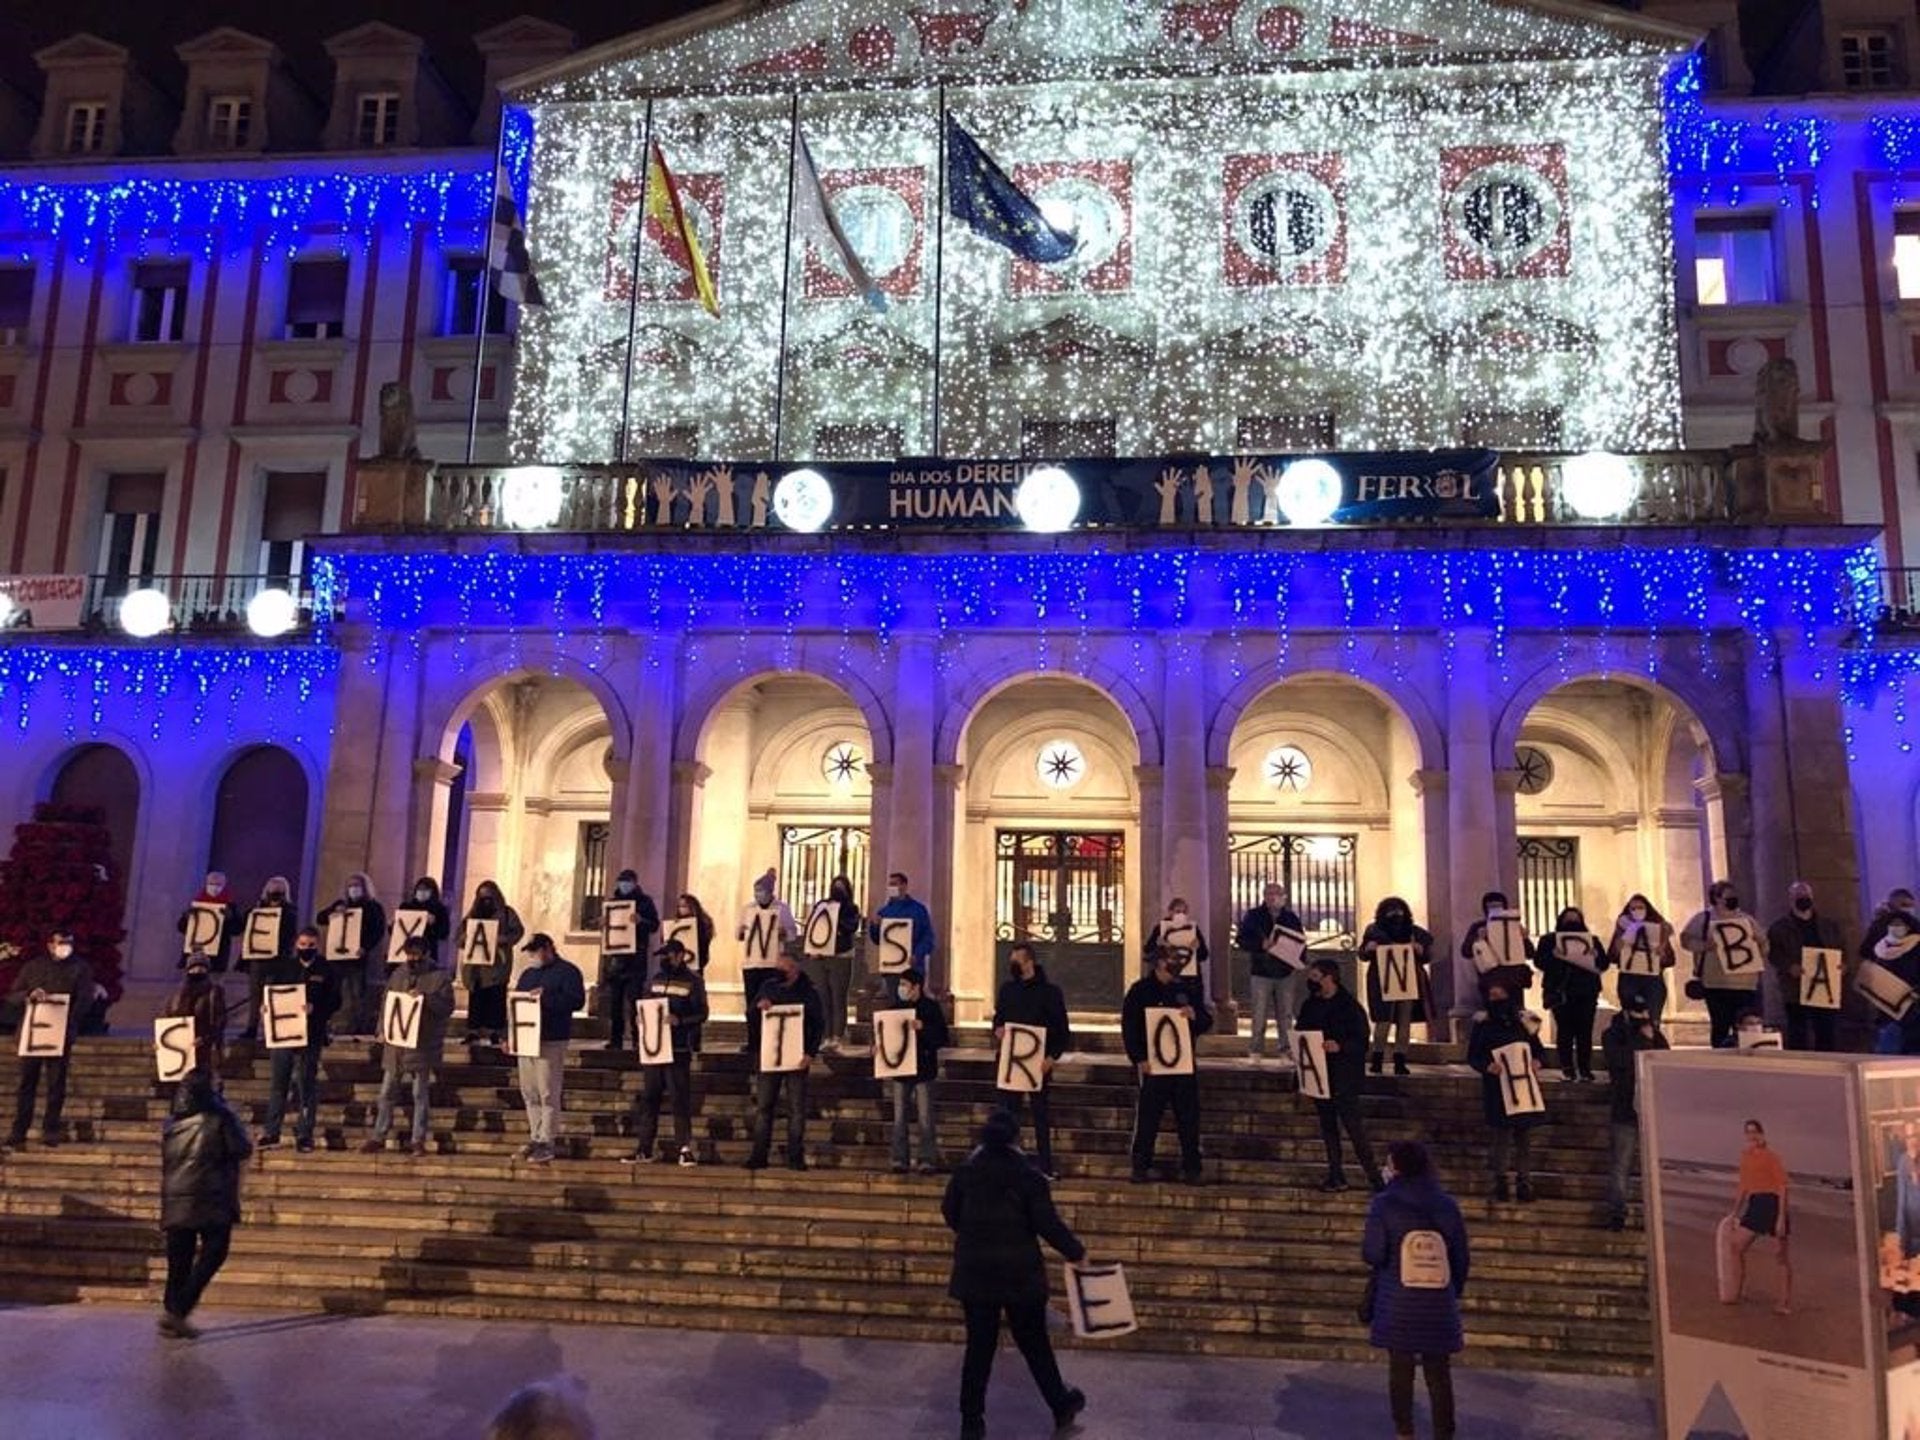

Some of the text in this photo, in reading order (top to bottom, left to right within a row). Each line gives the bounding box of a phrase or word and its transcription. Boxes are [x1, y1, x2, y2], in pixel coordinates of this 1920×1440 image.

[890, 463, 1065, 484] DIA DOS DEREIT
[890, 488, 1020, 518] HUMAN
[190, 907, 221, 949] D
[251, 911, 281, 956] E
[335, 906, 358, 954] I
[395, 917, 422, 955] X
[471, 919, 491, 962] A
[605, 903, 632, 949] E
[747, 913, 777, 959] N
[809, 908, 832, 948] O
[883, 922, 908, 967] S
[1487, 914, 1522, 962] T
[1624, 925, 1653, 972] A
[1716, 922, 1753, 970] B
[1382, 949, 1408, 994] N
[1806, 952, 1833, 1004] A
[28, 999, 67, 1052] E
[267, 987, 304, 1043] E
[388, 996, 419, 1042] N
[511, 996, 538, 1053] F
[640, 1003, 665, 1057] U
[766, 1011, 801, 1067] T
[160, 1022, 189, 1077] S
[878, 1019, 909, 1069] U
[1006, 1026, 1038, 1088] R
[1154, 1014, 1181, 1068] O
[1298, 1035, 1325, 1096] A
[1500, 1049, 1537, 1107] H
[1072, 1268, 1132, 1334] E
